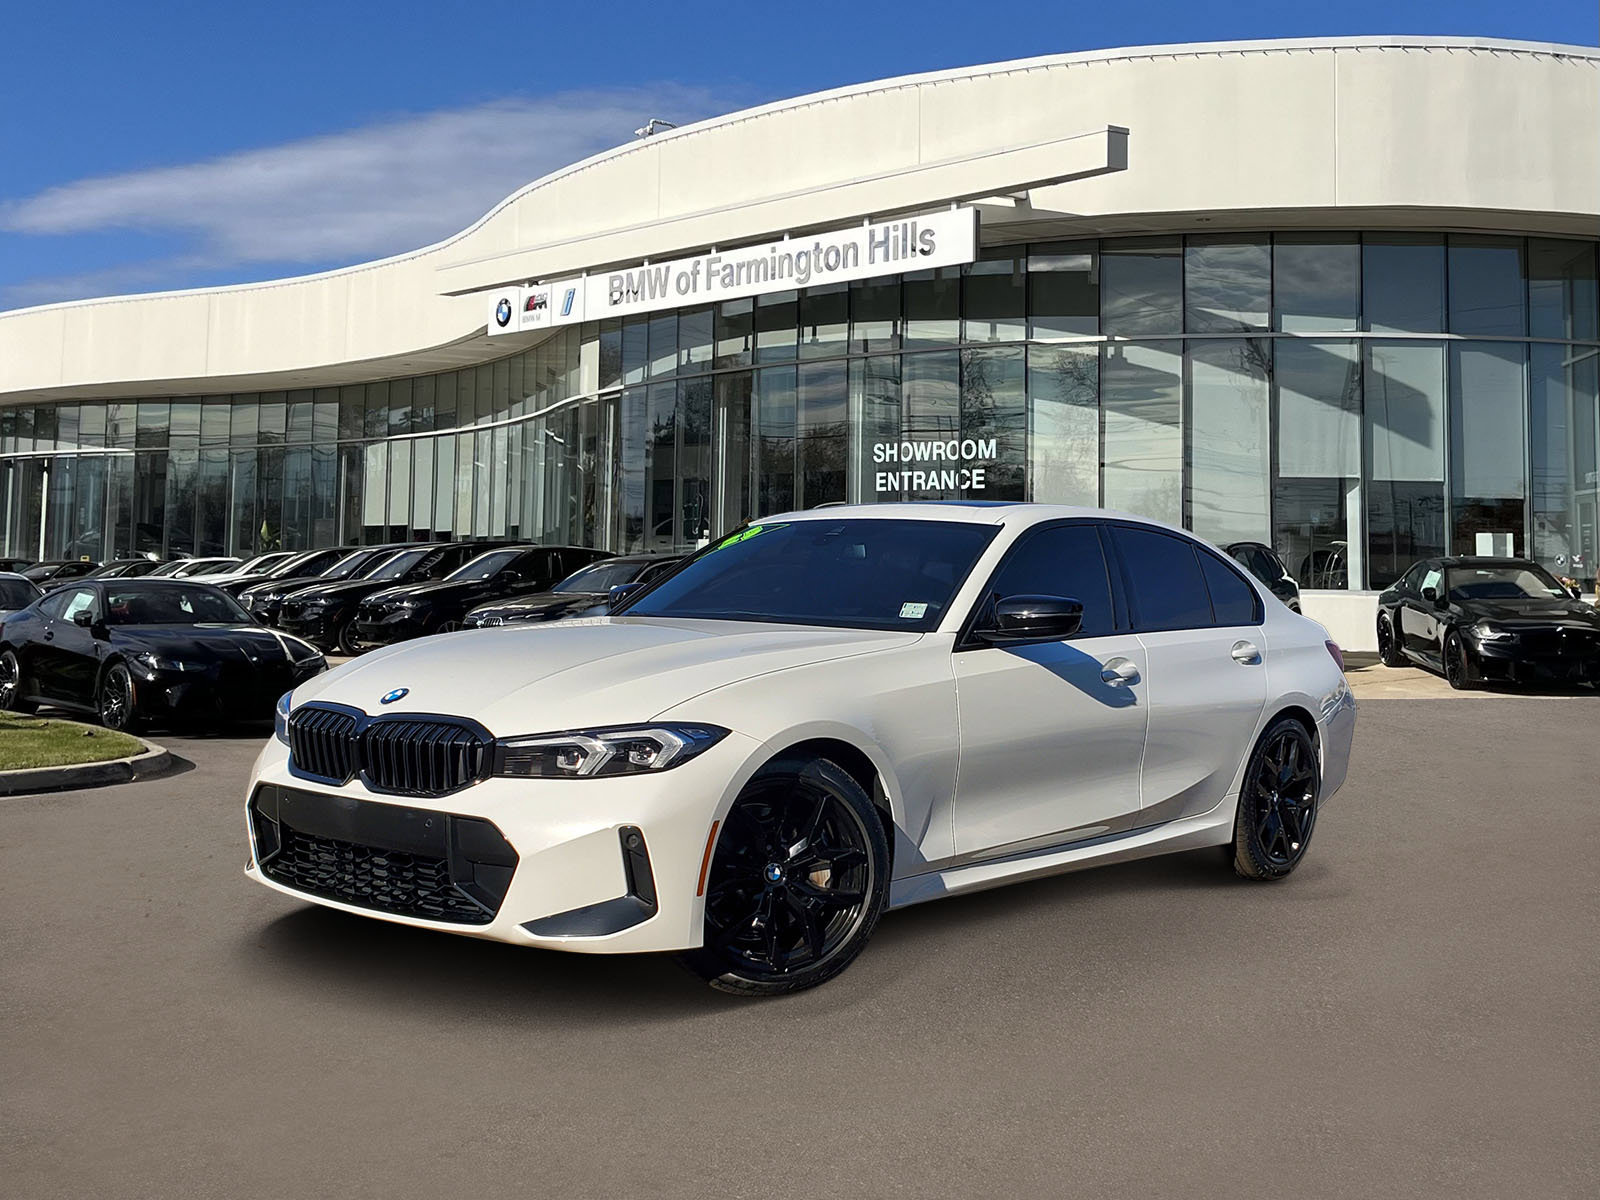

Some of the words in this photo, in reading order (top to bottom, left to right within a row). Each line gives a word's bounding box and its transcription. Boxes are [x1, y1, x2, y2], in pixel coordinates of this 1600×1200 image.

[608, 265, 671, 307] BMW
[675, 259, 701, 296] of
[705, 241, 859, 292] Farmington
[868, 220, 936, 266] Hills
[872, 438, 997, 463] SHOWROOM
[875, 468, 986, 492] ENTRANCE
